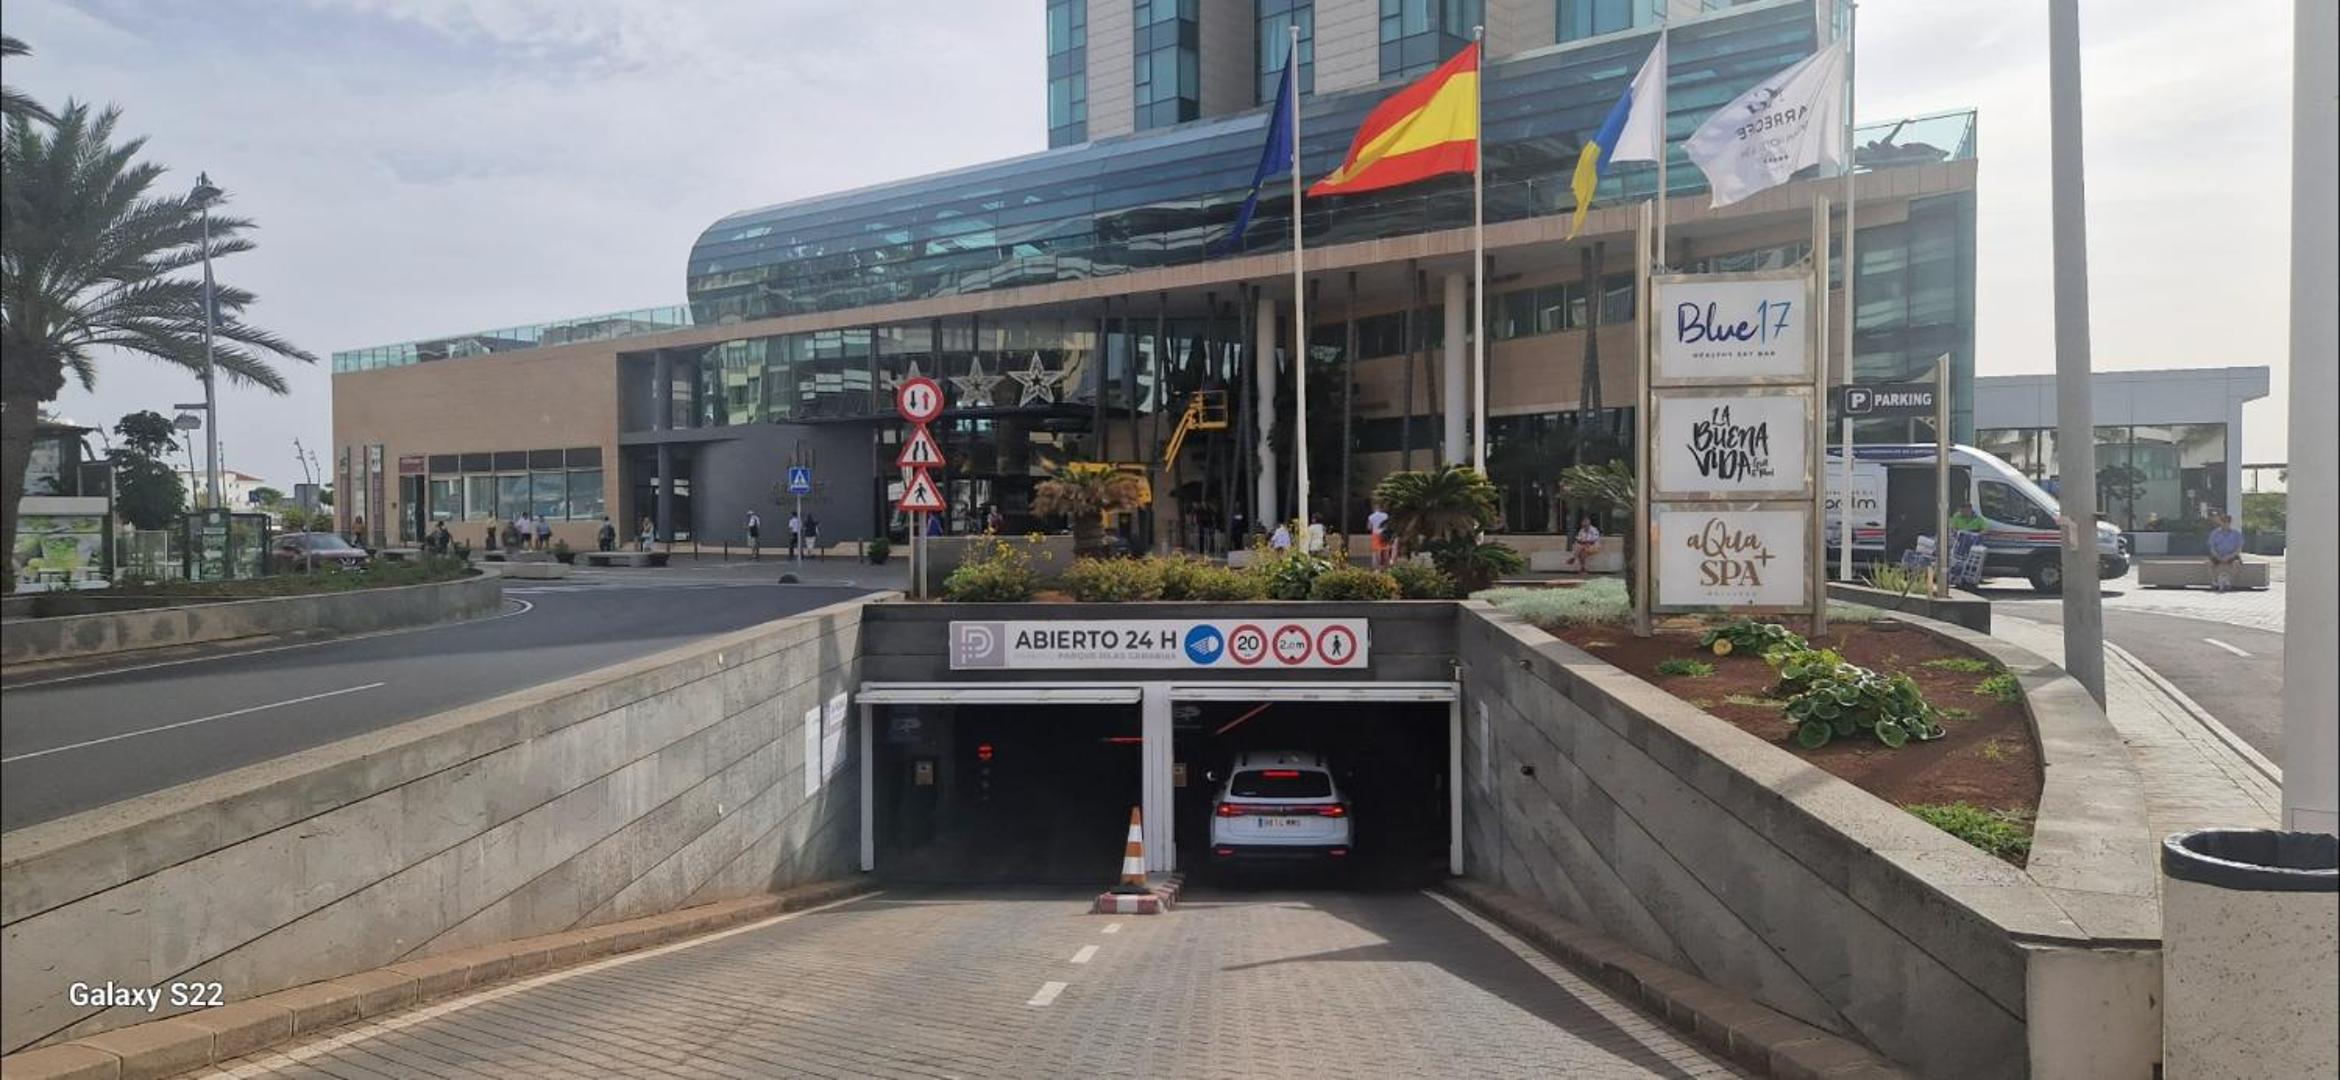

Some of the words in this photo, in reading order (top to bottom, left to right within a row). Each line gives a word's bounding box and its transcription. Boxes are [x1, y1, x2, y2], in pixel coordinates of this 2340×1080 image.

[1851, 392, 1866, 409] P
[1874, 393, 1932, 407] PARKING
[1711, 404, 1731, 428] LA
[1015, 630, 1119, 650] ABIERTO
[1125, 630, 1154, 650] 24
[1160, 630, 1177, 650] H
[1238, 635, 1260, 651] 20
